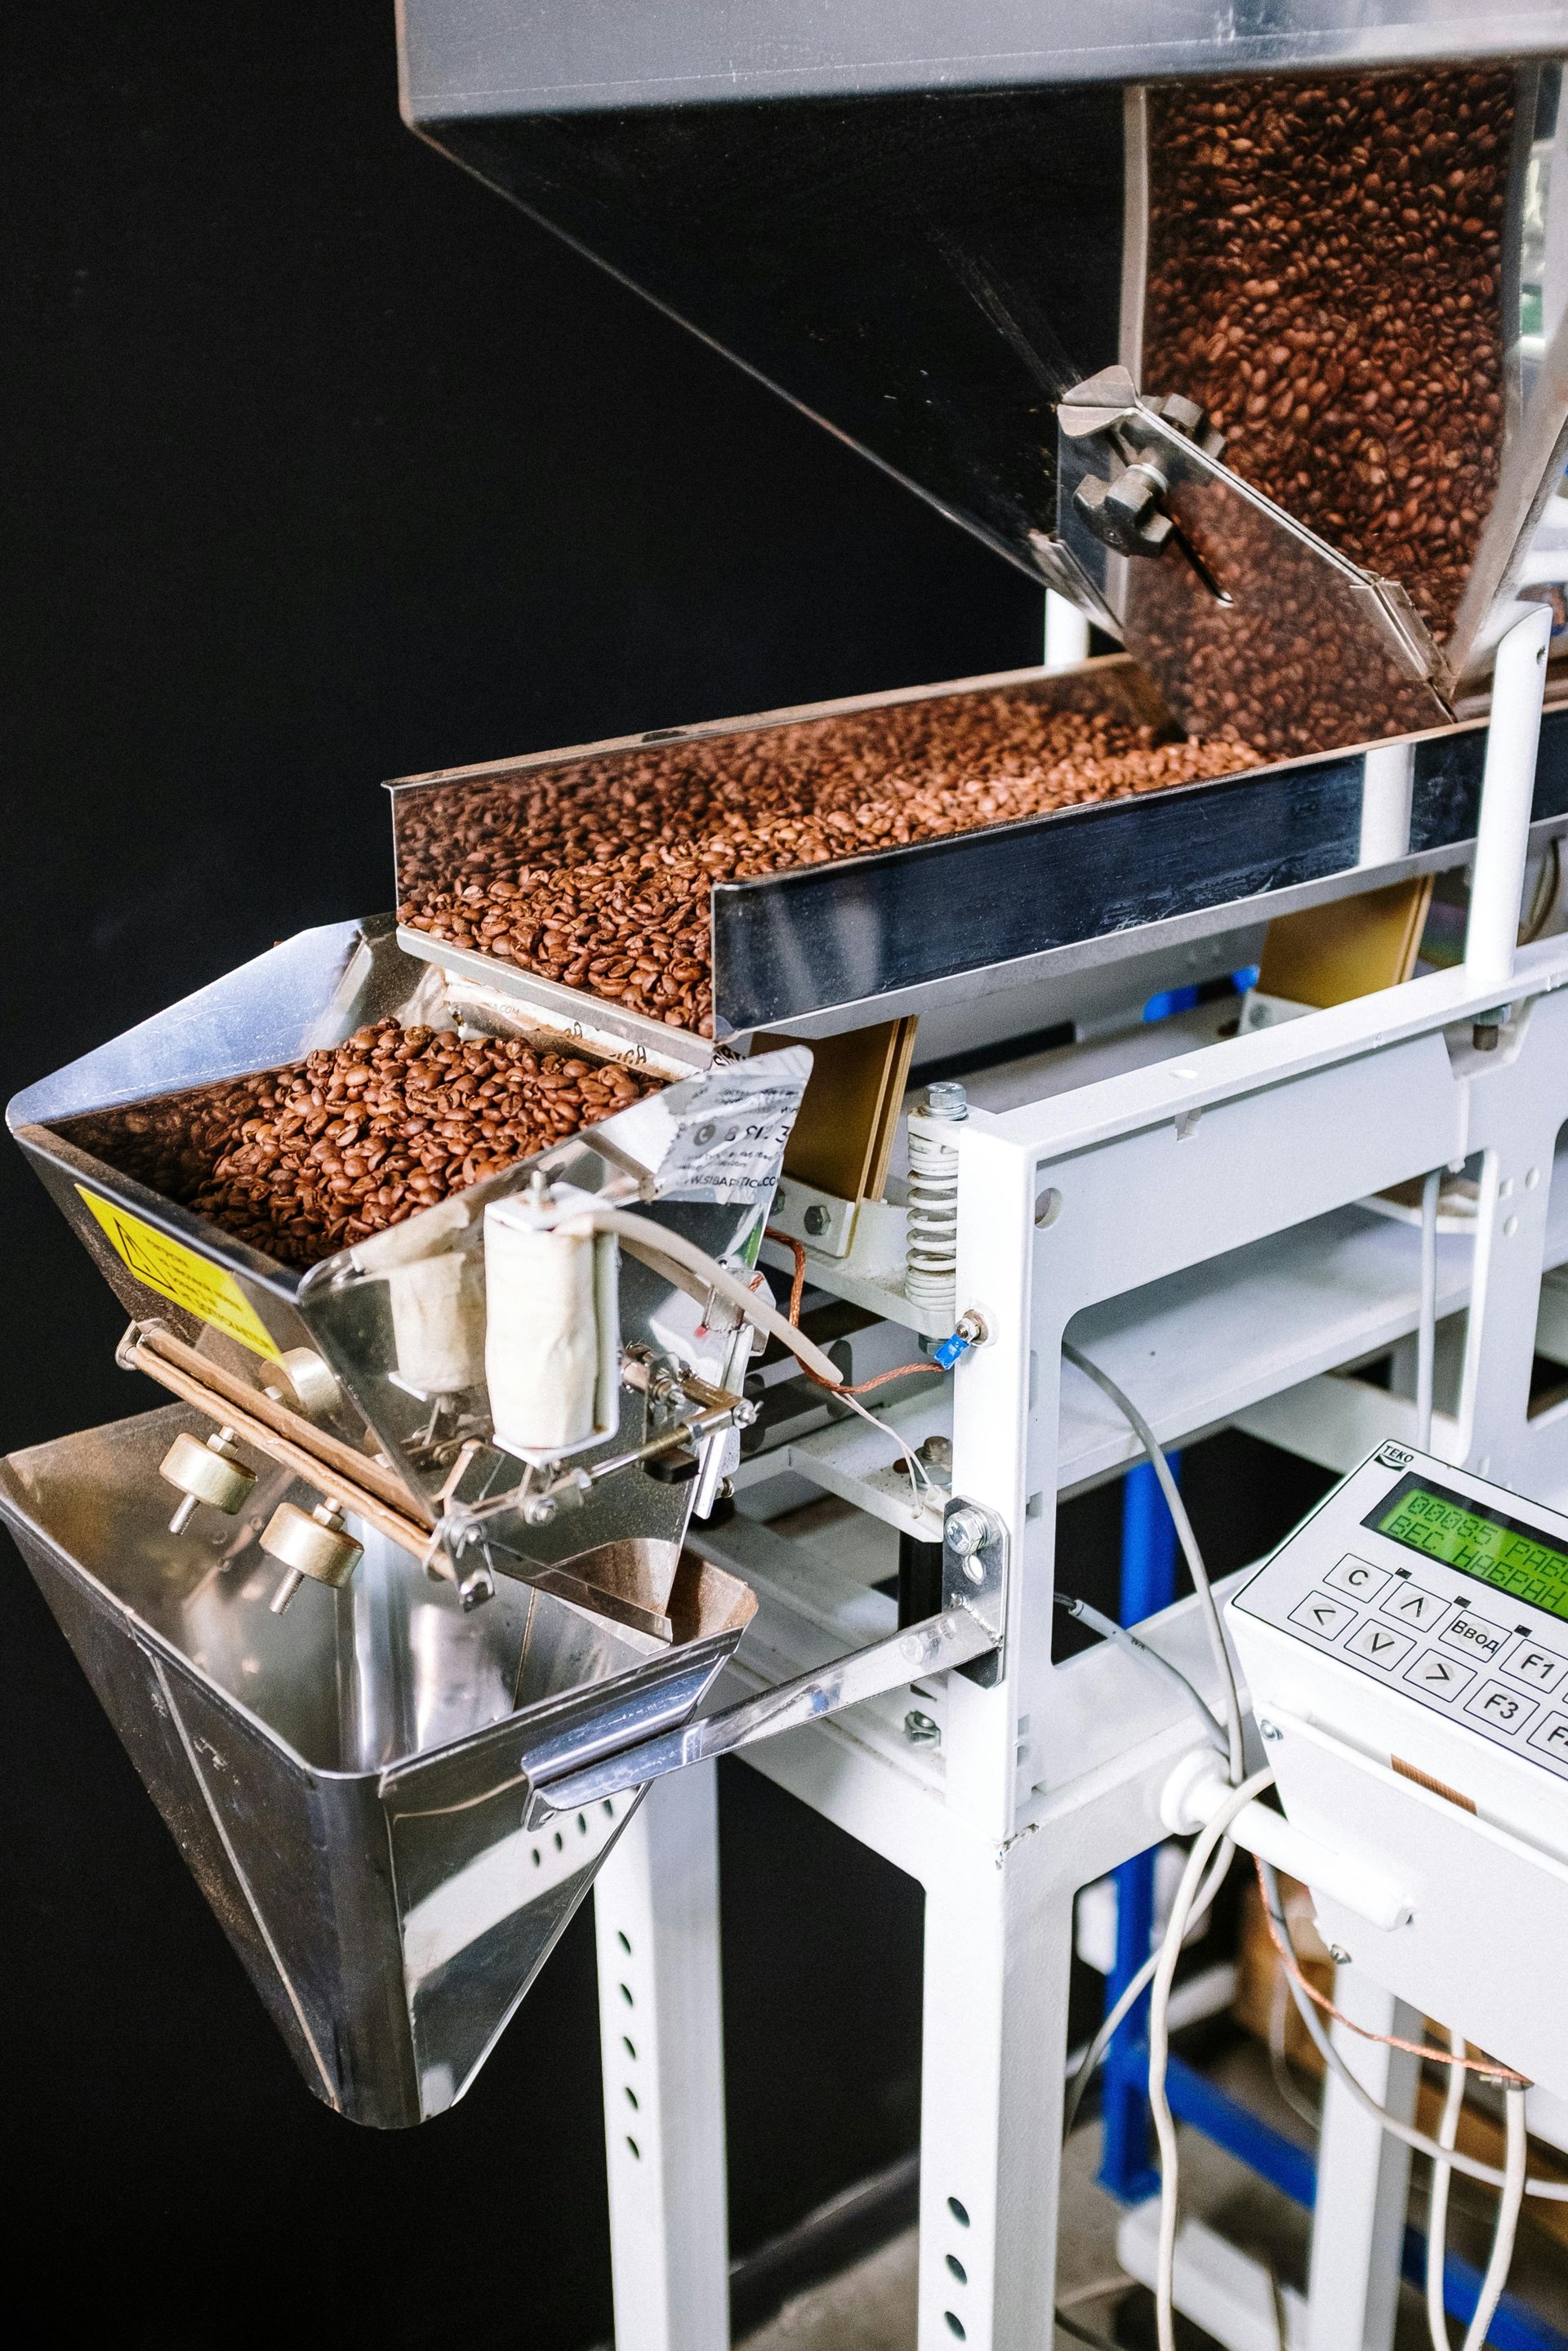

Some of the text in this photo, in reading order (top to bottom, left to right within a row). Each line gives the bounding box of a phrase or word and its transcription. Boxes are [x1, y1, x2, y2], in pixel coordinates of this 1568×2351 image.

[1406, 1495, 1499, 1546] 00085
[1388, 1514, 1568, 1610] ВЕС НАБРАН
[1348, 1570, 1369, 1586] C
[1520, 1654, 1556, 1679] F1
[1483, 1693, 1520, 1719] F3
